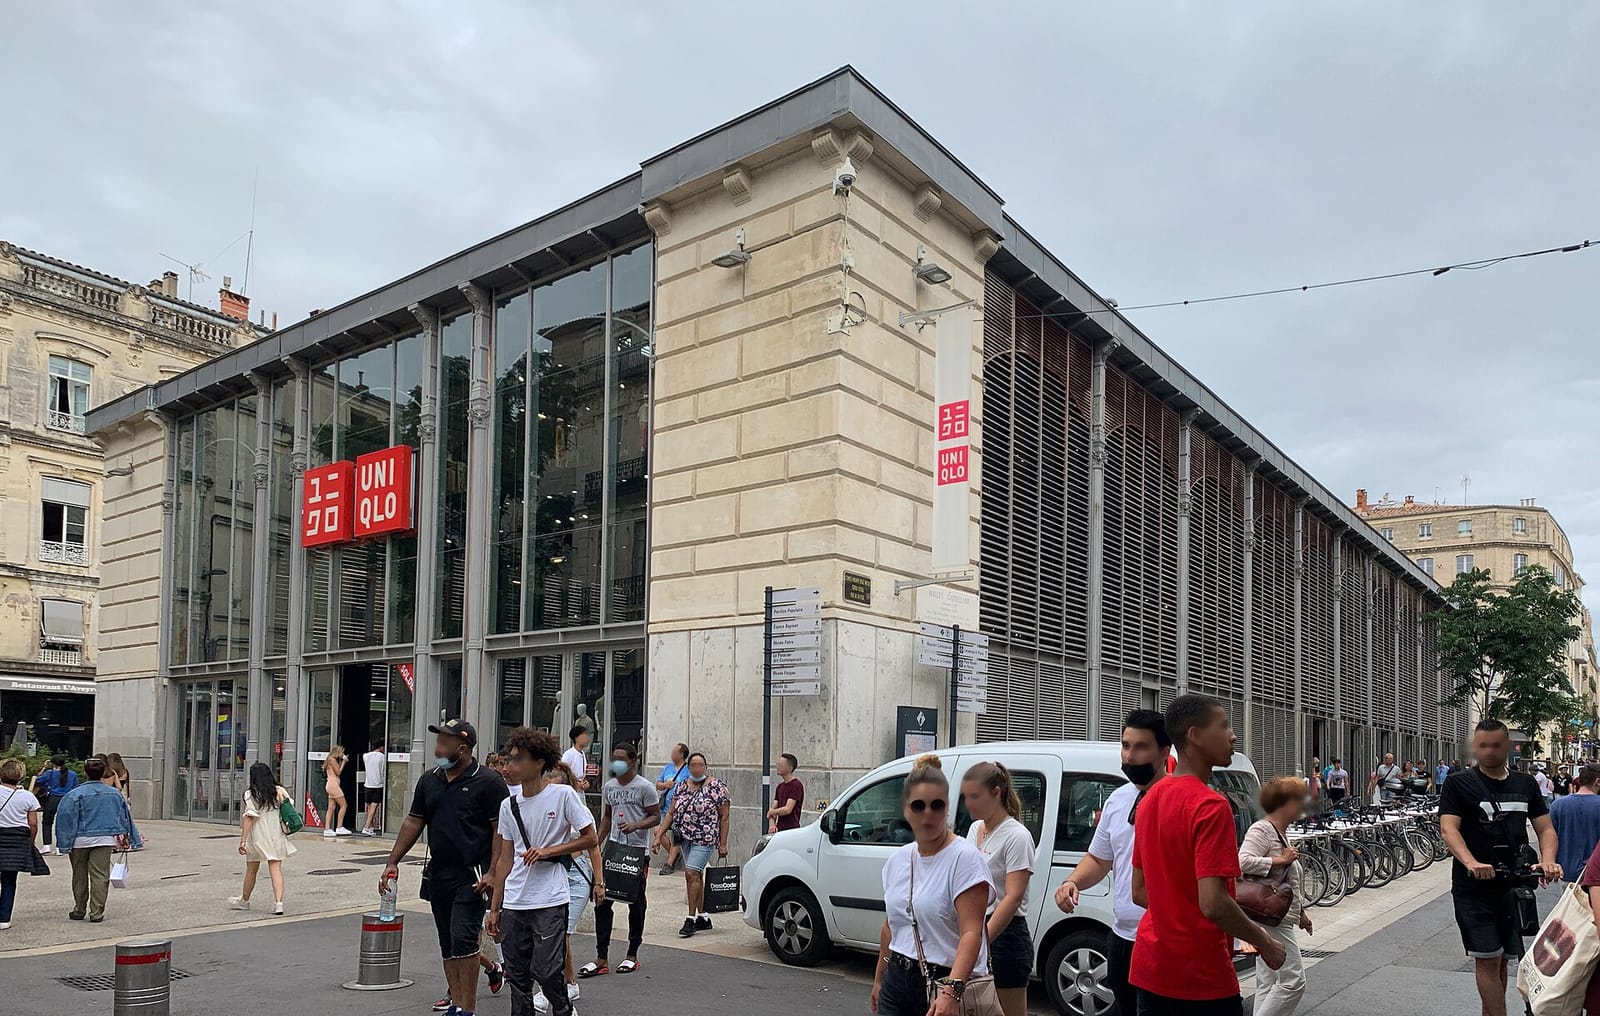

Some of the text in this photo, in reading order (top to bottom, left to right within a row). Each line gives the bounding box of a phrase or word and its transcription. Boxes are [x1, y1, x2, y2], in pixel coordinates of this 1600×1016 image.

[941, 450, 963, 466] UNI
[361, 457, 395, 492] UNI
[941, 466, 965, 482] QLO
[360, 491, 397, 529] QLO
[11, 681, 61, 690] Restaurant
[401, 664, 415, 691] SOLDE
[306, 798, 320, 827] SOLDES
